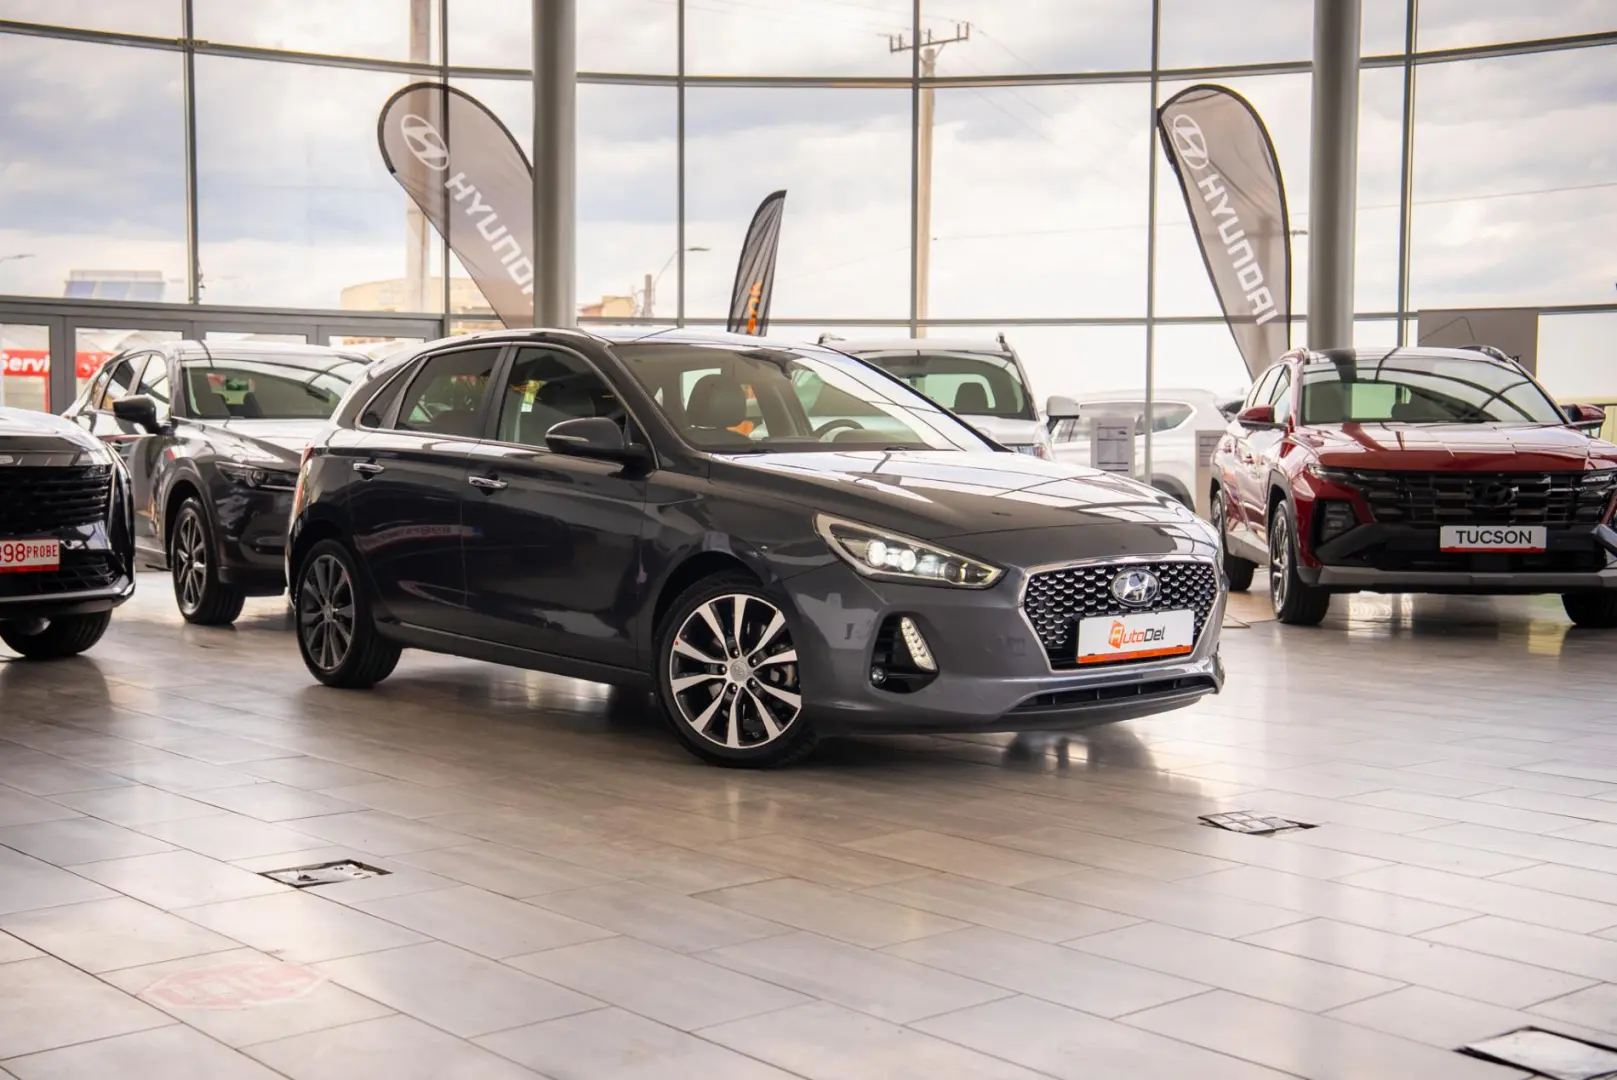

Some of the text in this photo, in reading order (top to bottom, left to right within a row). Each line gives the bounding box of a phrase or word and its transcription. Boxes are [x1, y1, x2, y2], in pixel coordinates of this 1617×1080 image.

[444, 172, 533, 304] HYUND
[1198, 174, 1278, 326] HYUNDAI
[0, 543, 58, 563] 98 PROBE
[1456, 530, 1532, 545] TUCSON
